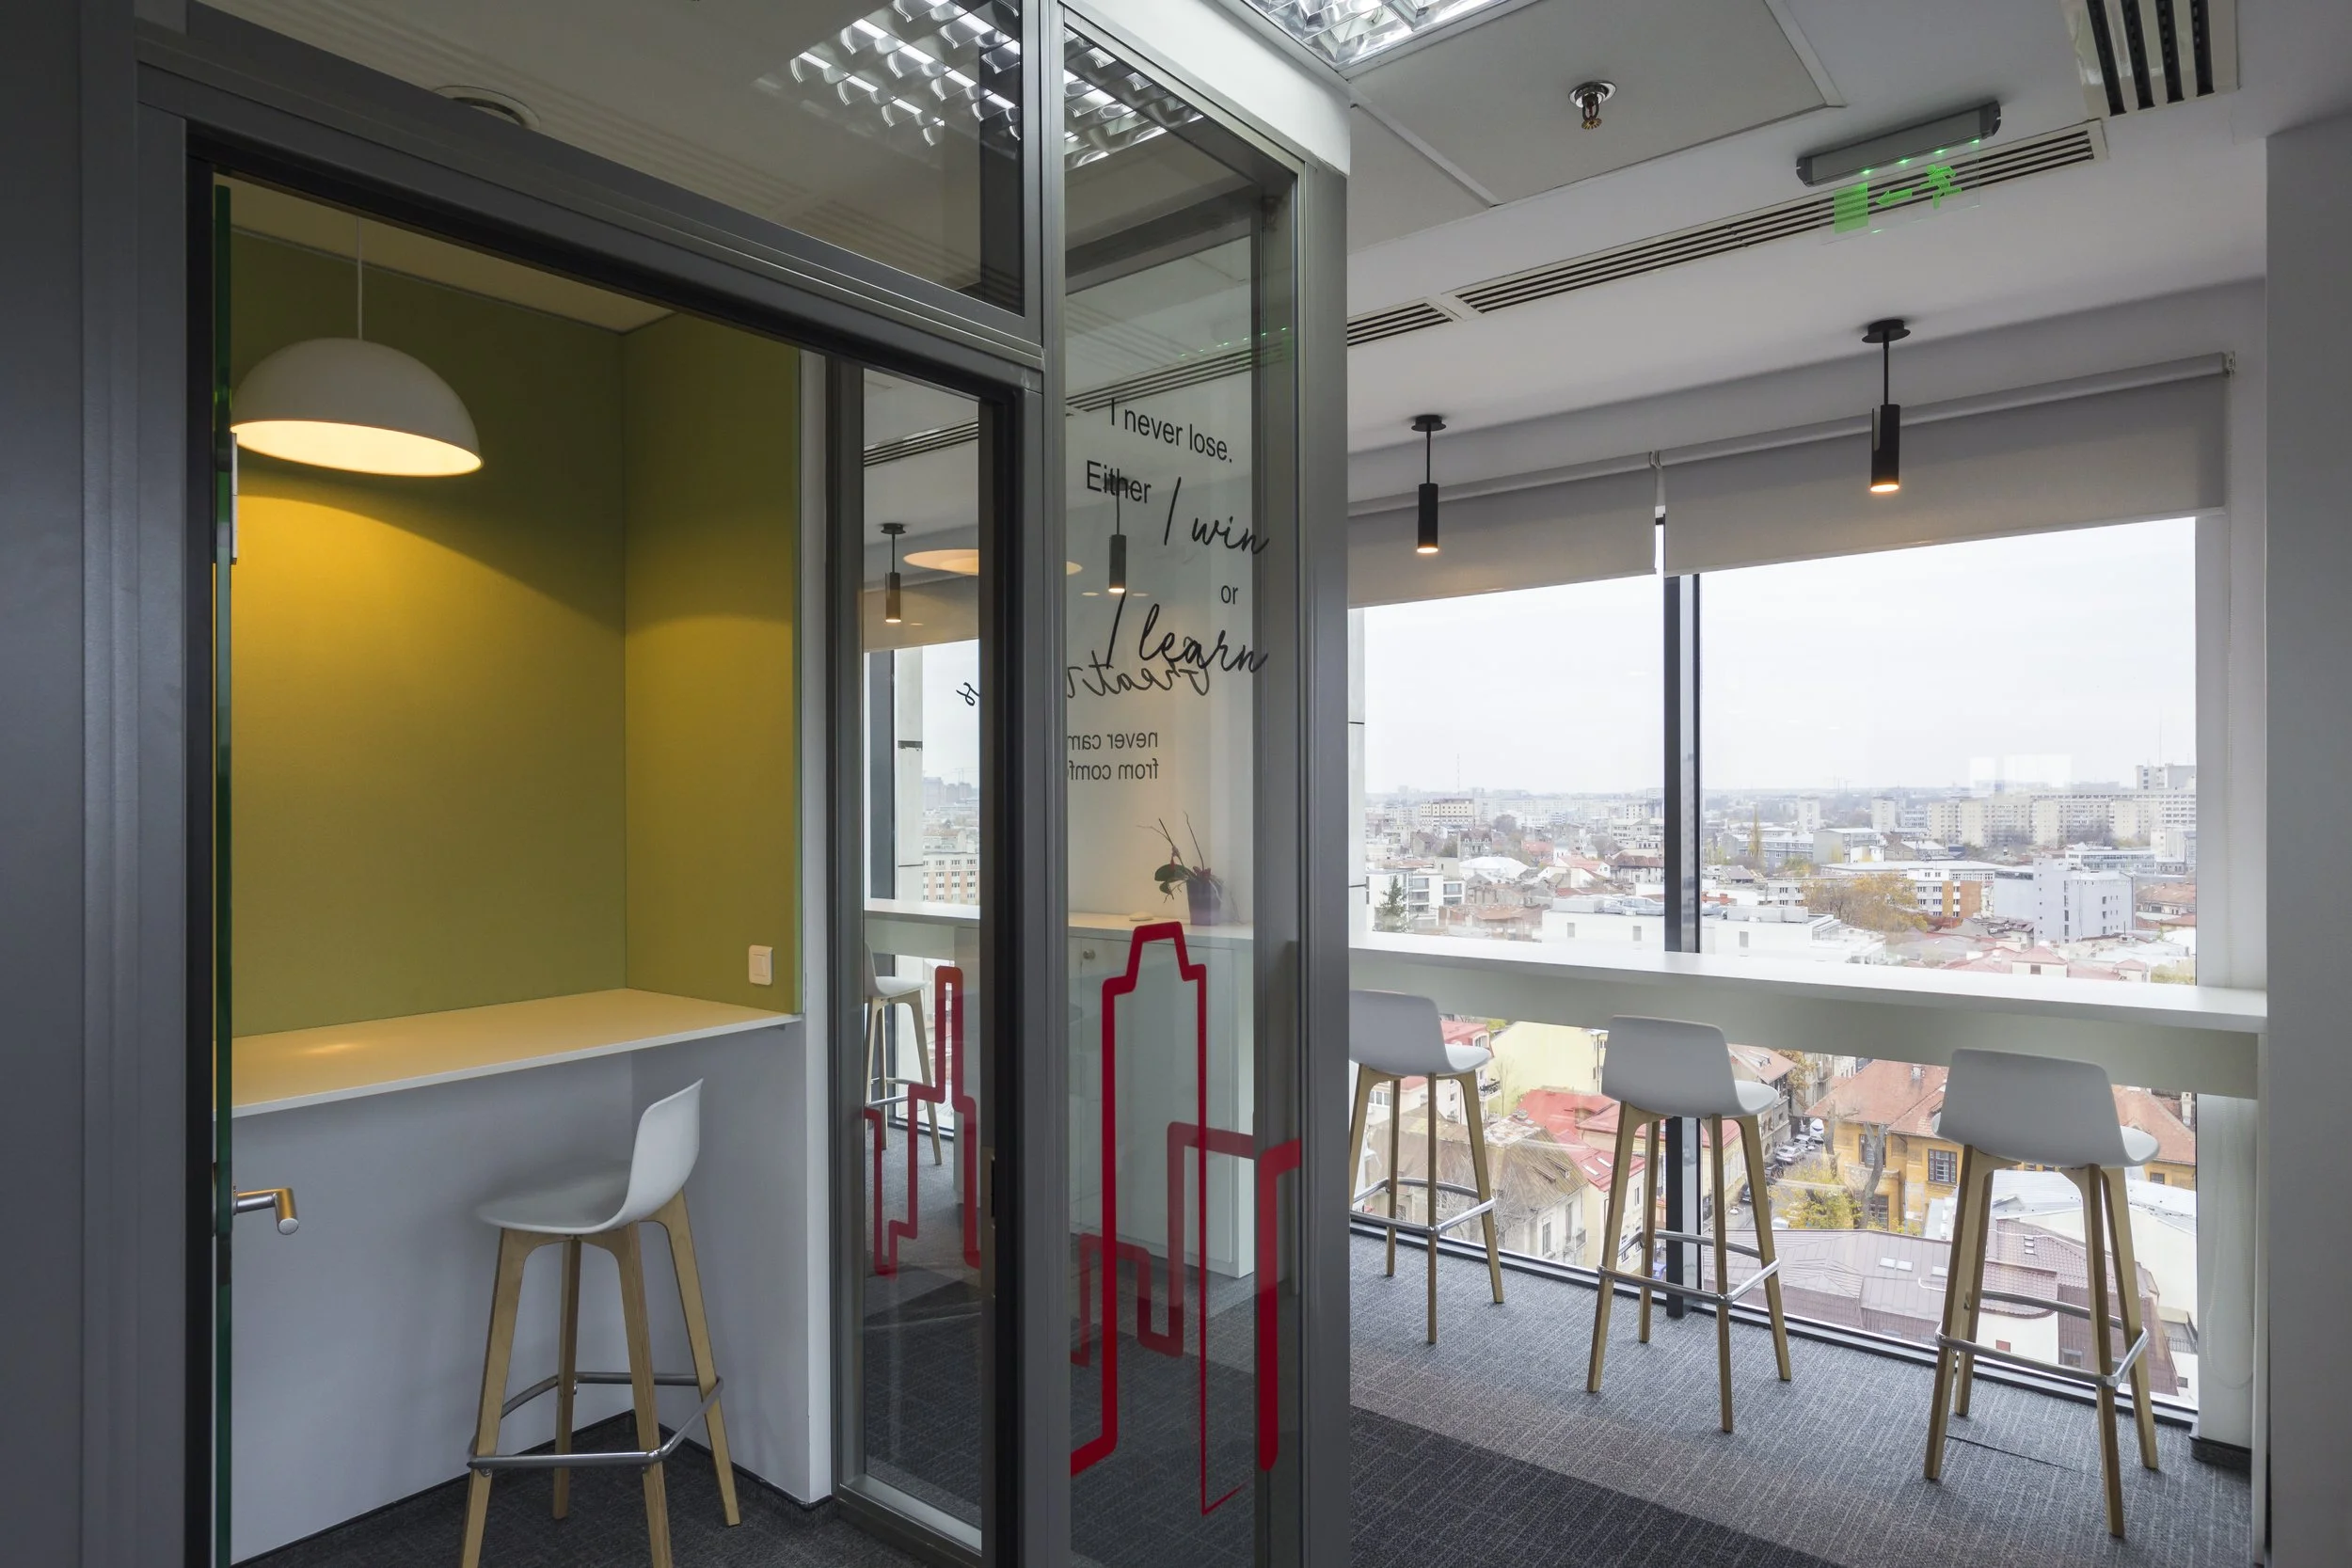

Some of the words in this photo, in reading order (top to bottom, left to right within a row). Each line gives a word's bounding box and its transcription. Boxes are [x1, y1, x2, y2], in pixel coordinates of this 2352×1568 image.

[1123, 407, 1184, 447] never
[1188, 423, 1233, 464] lose.
[1086, 459, 1152, 504] Either
[1190, 515, 1270, 556] win
[1219, 584, 1239, 606] or
[1137, 603, 1269, 674] learn
